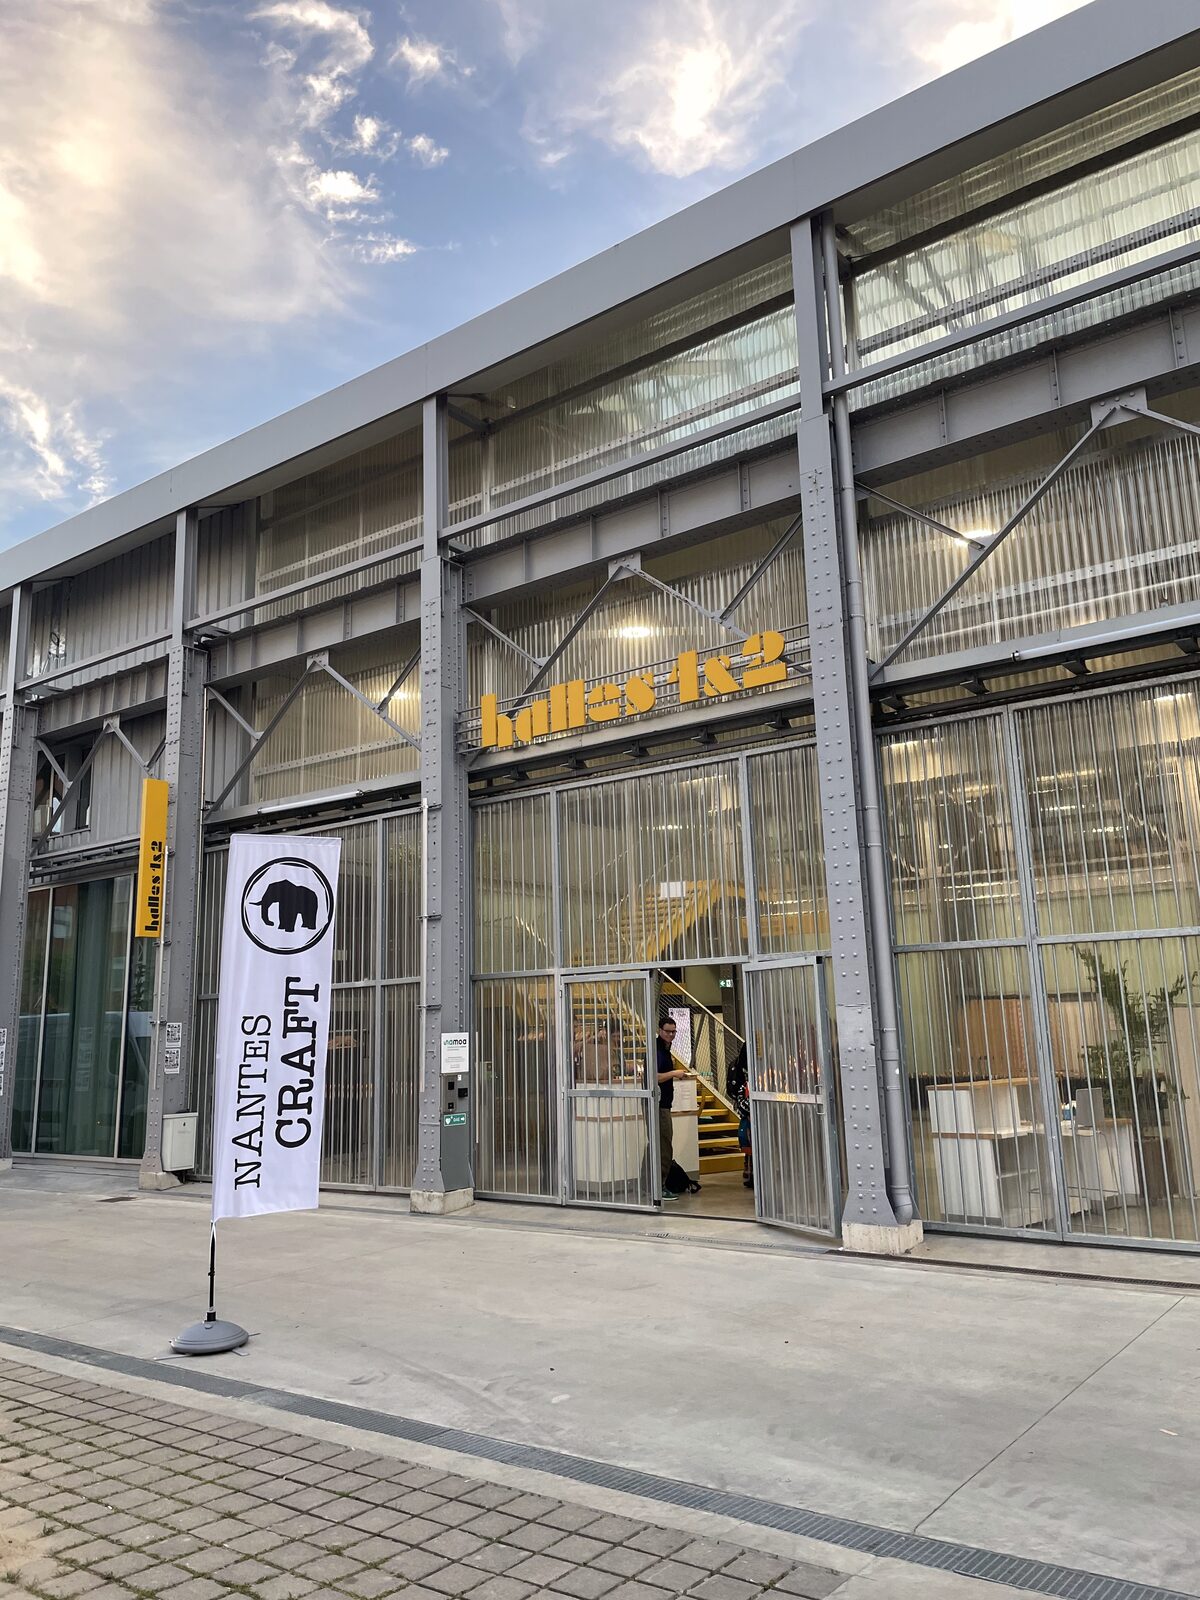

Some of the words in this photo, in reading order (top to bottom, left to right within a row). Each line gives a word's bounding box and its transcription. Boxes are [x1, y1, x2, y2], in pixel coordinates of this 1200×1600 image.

[481, 679, 655, 748] halles
[145, 875, 160, 931] halles
[231, 1014, 272, 1190] NANTES
[275, 976, 320, 1148] CRAFT
